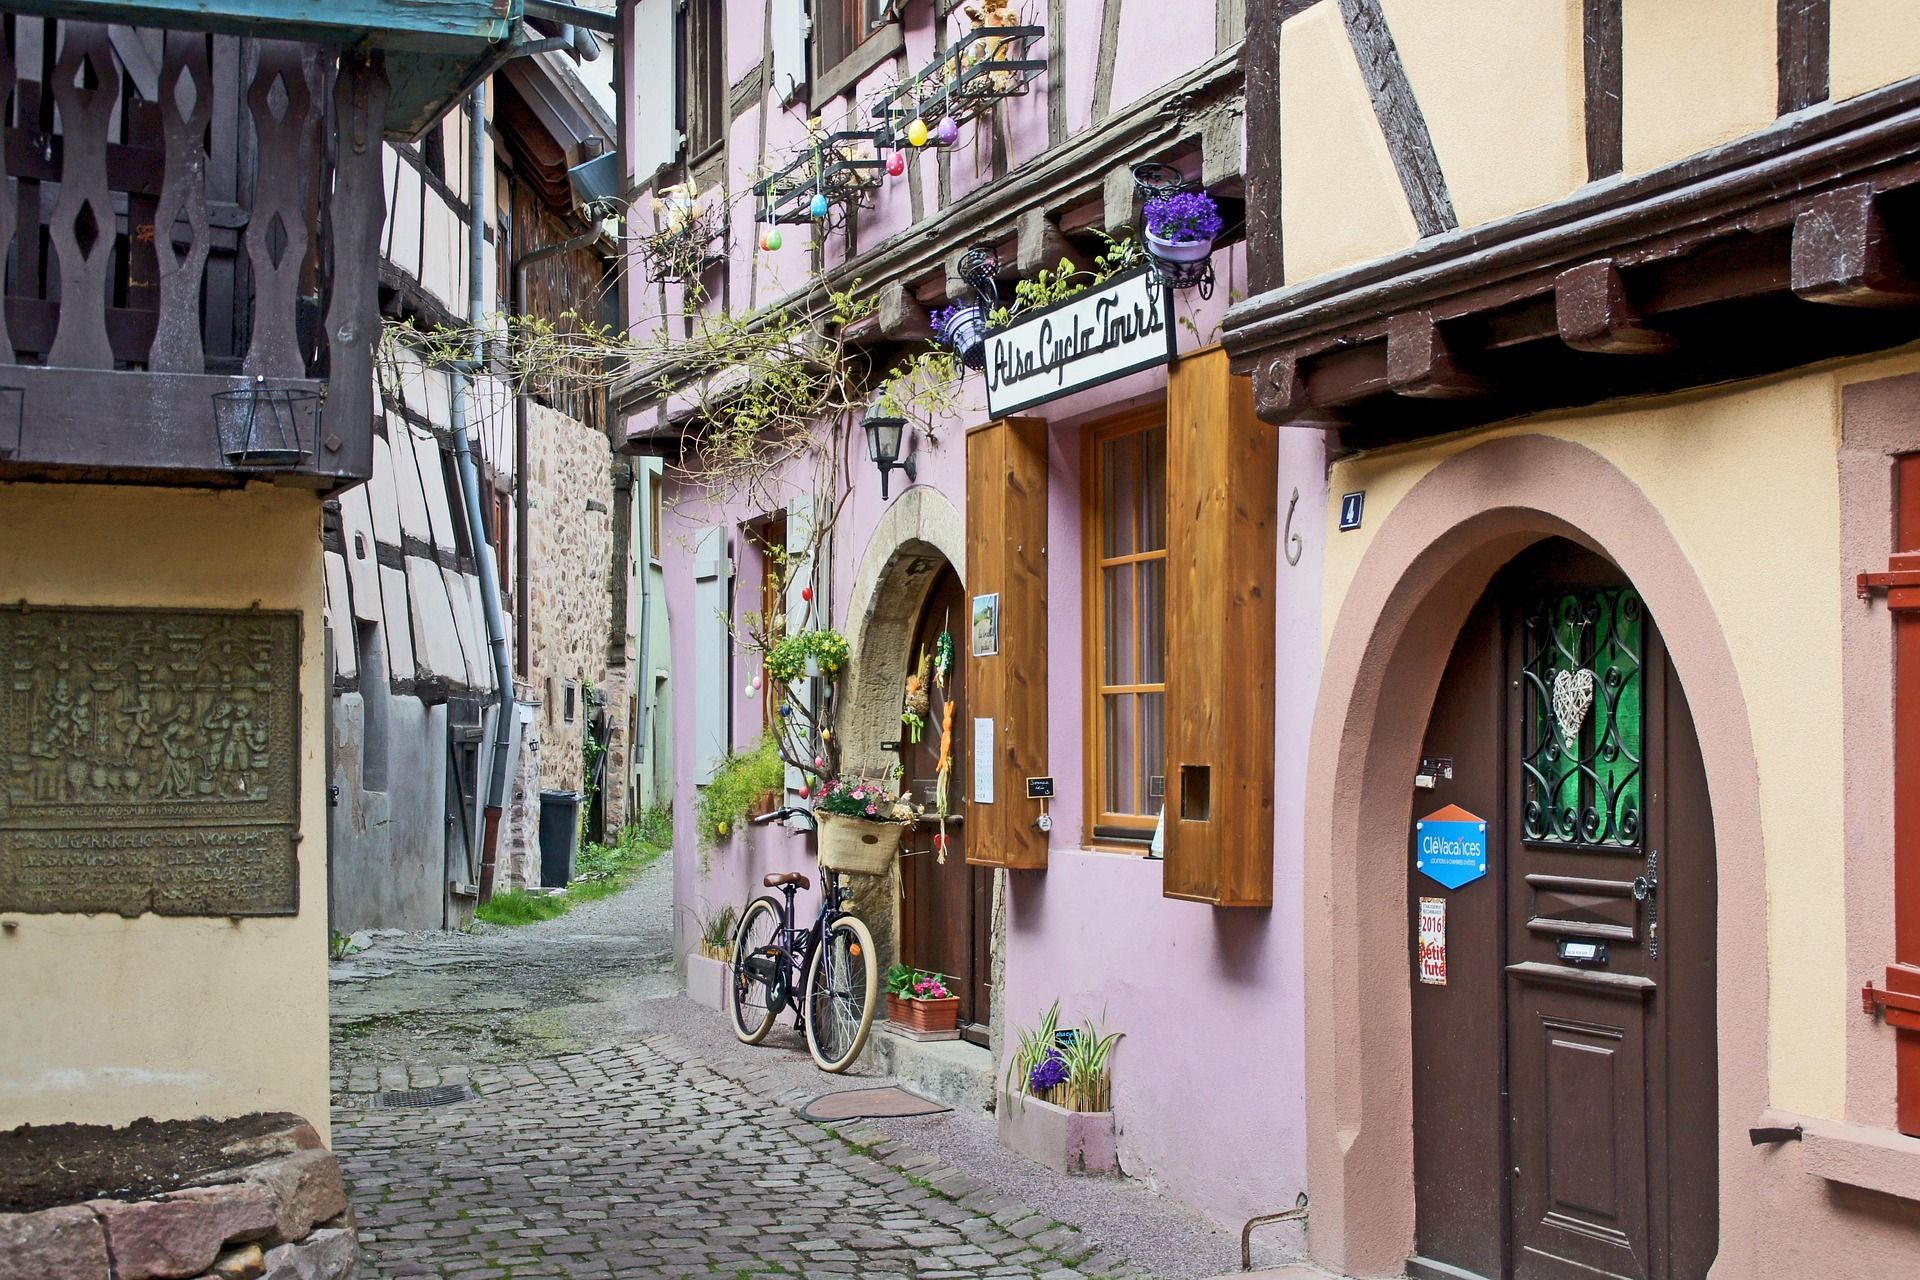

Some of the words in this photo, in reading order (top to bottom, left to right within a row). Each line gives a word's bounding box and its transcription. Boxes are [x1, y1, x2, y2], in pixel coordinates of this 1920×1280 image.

[990, 338, 1034, 392] Alsa
[1039, 314, 1095, 386] Cyclo
[1096, 290, 1164, 352] Tours
[1422, 916, 1442, 933] 2016
